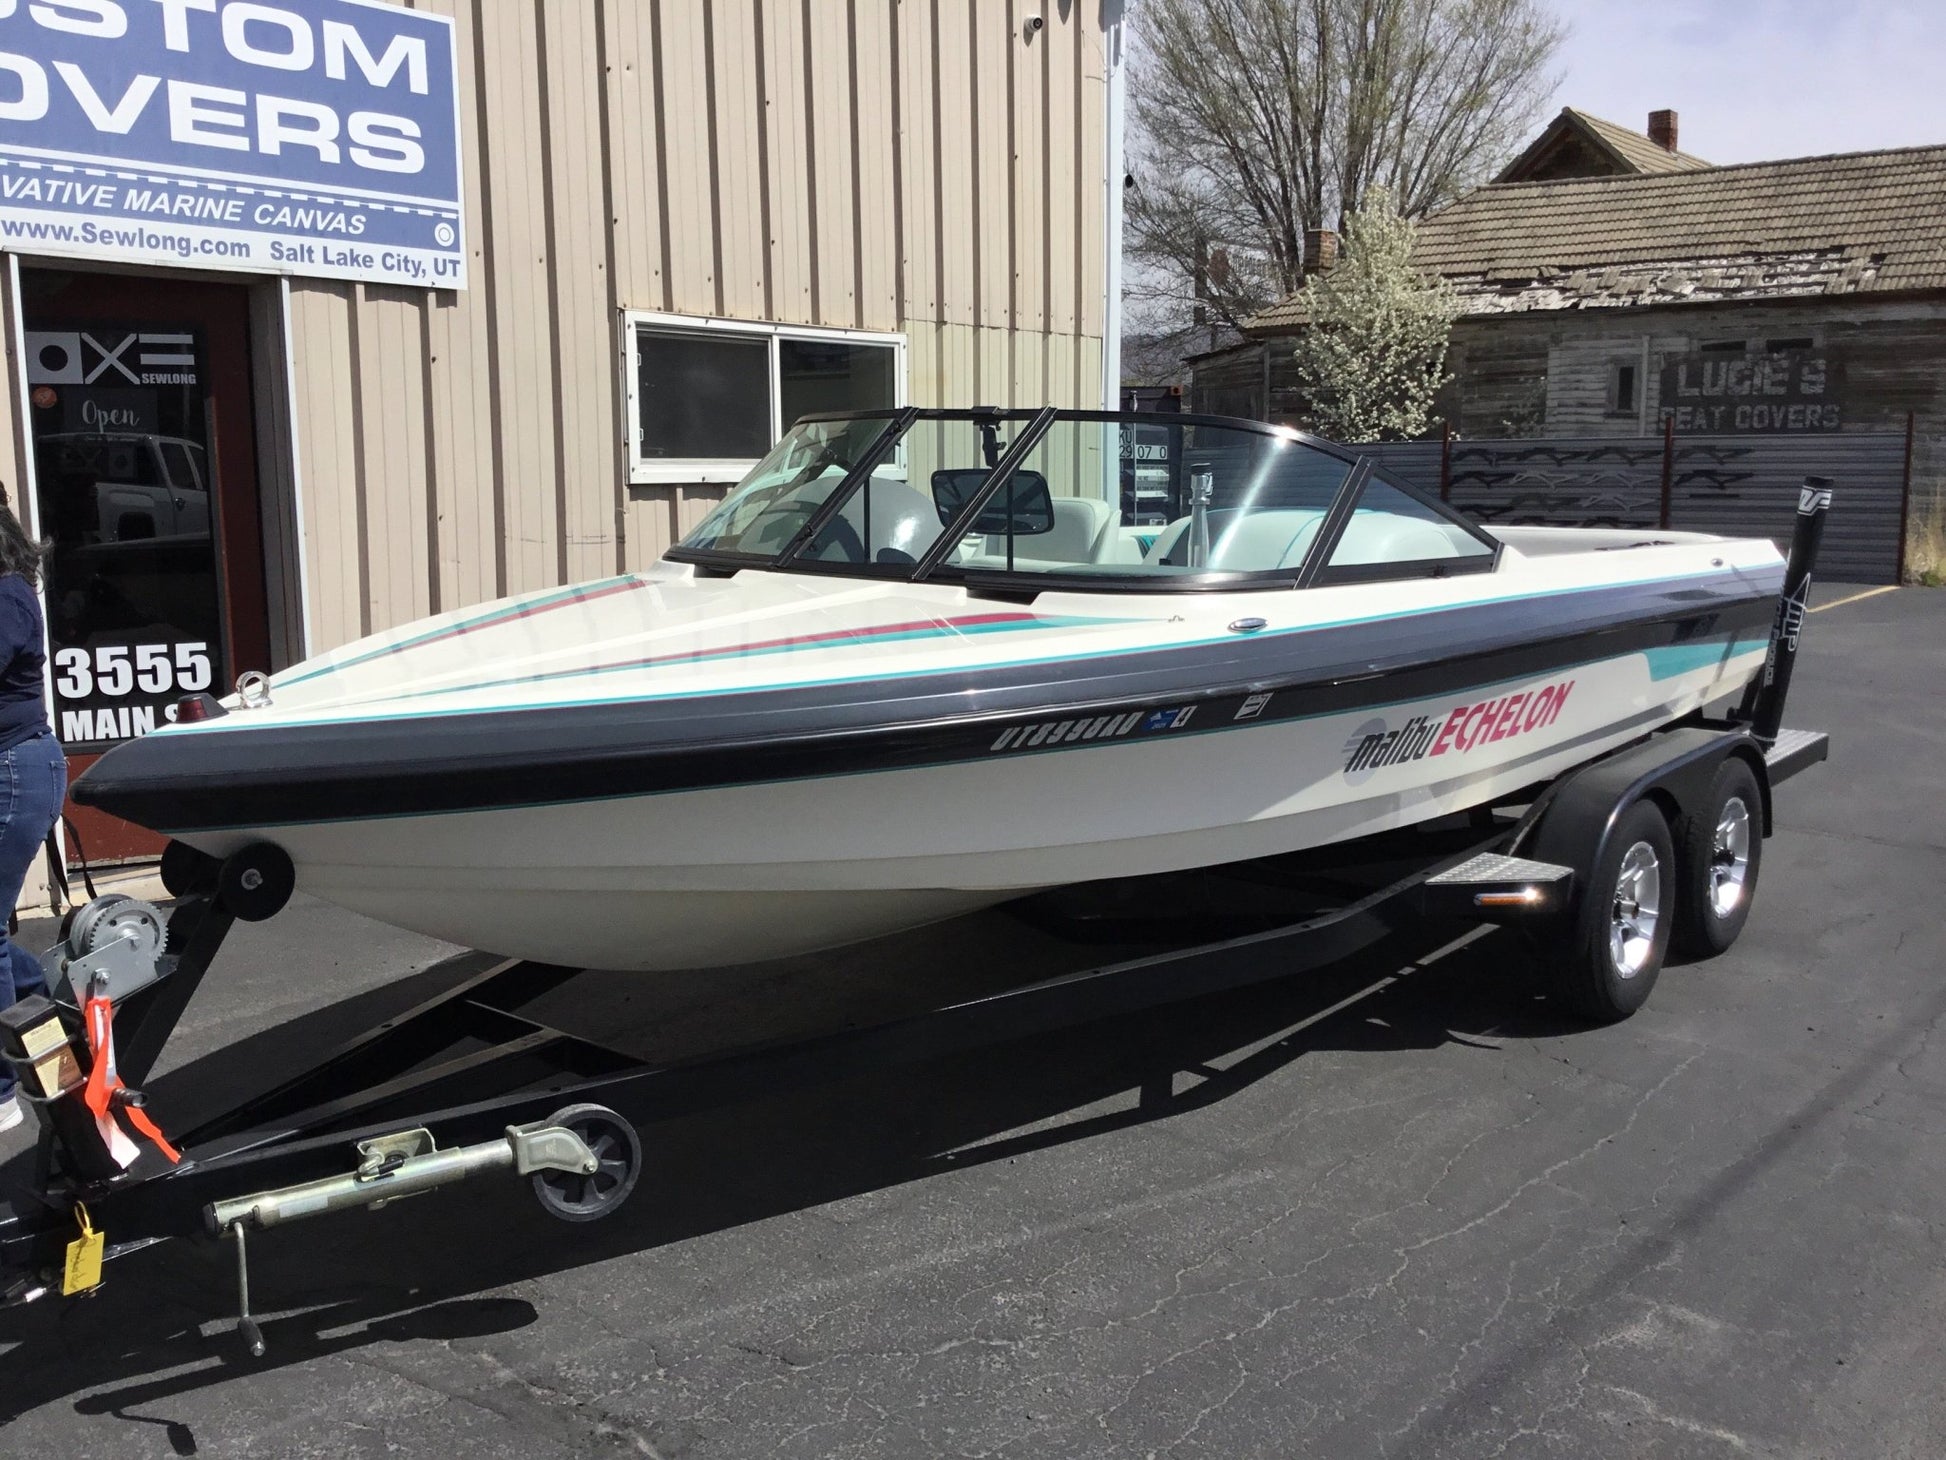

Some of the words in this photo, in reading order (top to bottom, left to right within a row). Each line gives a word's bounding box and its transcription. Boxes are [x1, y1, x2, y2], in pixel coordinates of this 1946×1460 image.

[0, 0, 429, 95] STOM
[2, 174, 117, 208] VATIVE
[123, 189, 246, 222] MARINE
[254, 203, 366, 235] CANVAS
[1, 219, 251, 258] www.Sewlong.com
[270, 240, 314, 264] Salt
[322, 245, 374, 269] Lake
[382, 252, 427, 278] City,
[433, 258, 461, 278] UT
[141, 373, 197, 384] SEWLONG
[82, 399, 140, 434] Open
[1735, 404, 1841, 430] COVERS
[55, 642, 212, 699] 3555
[61, 705, 156, 743] MAIN
[1428, 680, 1576, 757] ECHELON
